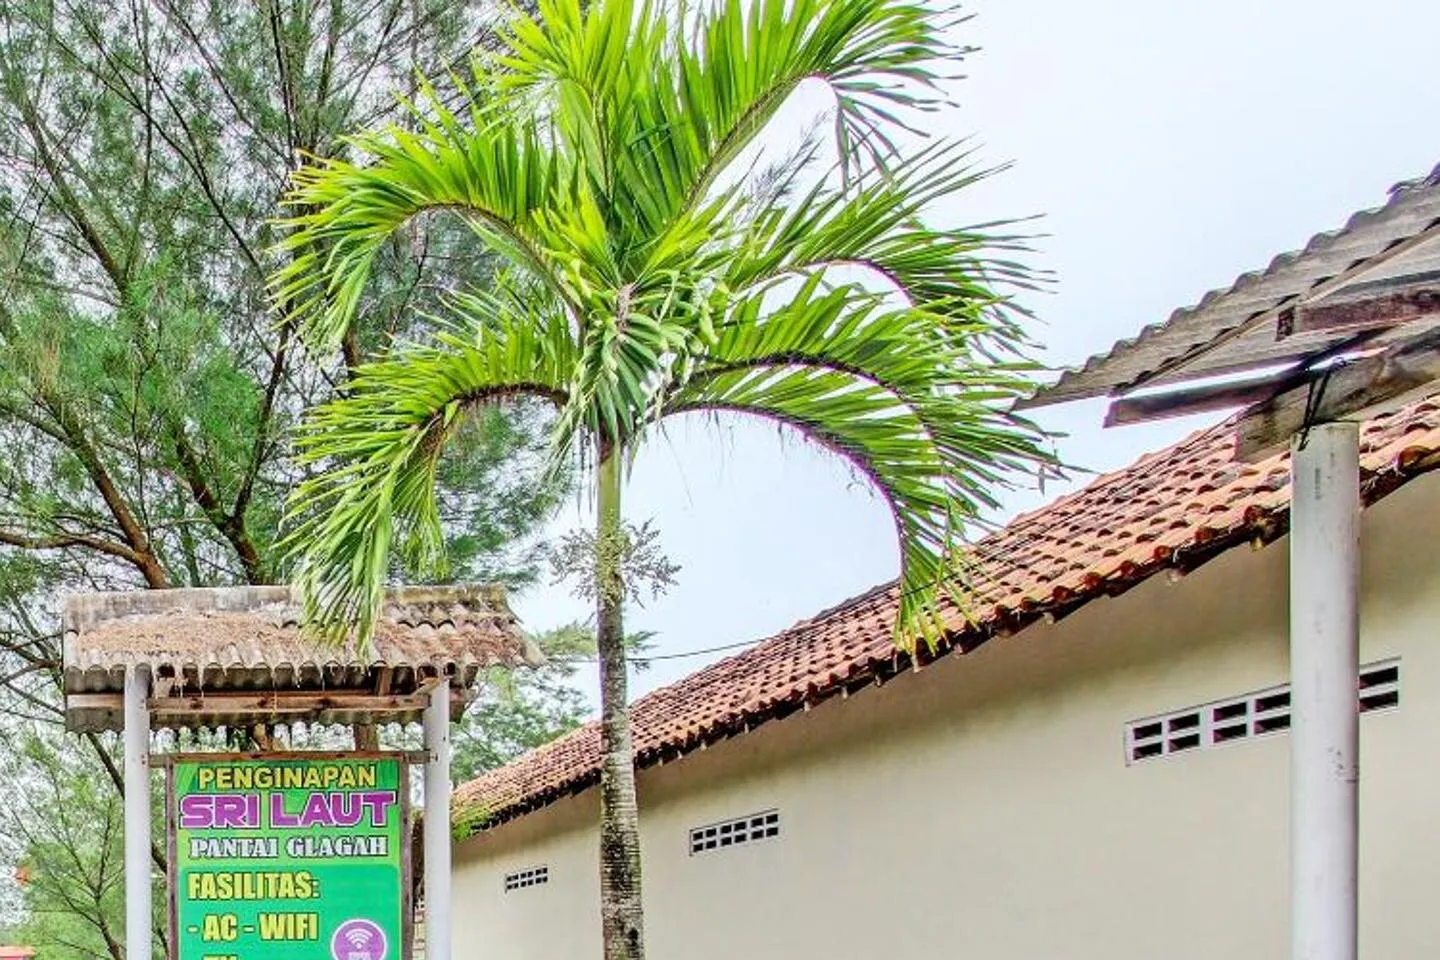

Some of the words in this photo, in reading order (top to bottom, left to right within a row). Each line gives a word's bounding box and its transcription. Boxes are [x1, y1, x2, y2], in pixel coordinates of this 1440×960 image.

[199, 766, 375, 788] PENGINAPAN
[179, 792, 260, 828] SRI
[271, 791, 396, 827] LAUT
[188, 837, 279, 858] PANTAI
[286, 836, 388, 856] GLAGAH
[188, 872, 320, 900] FASILITAS:
[203, 914, 237, 941] AC
[259, 913, 319, 940] WIFI
